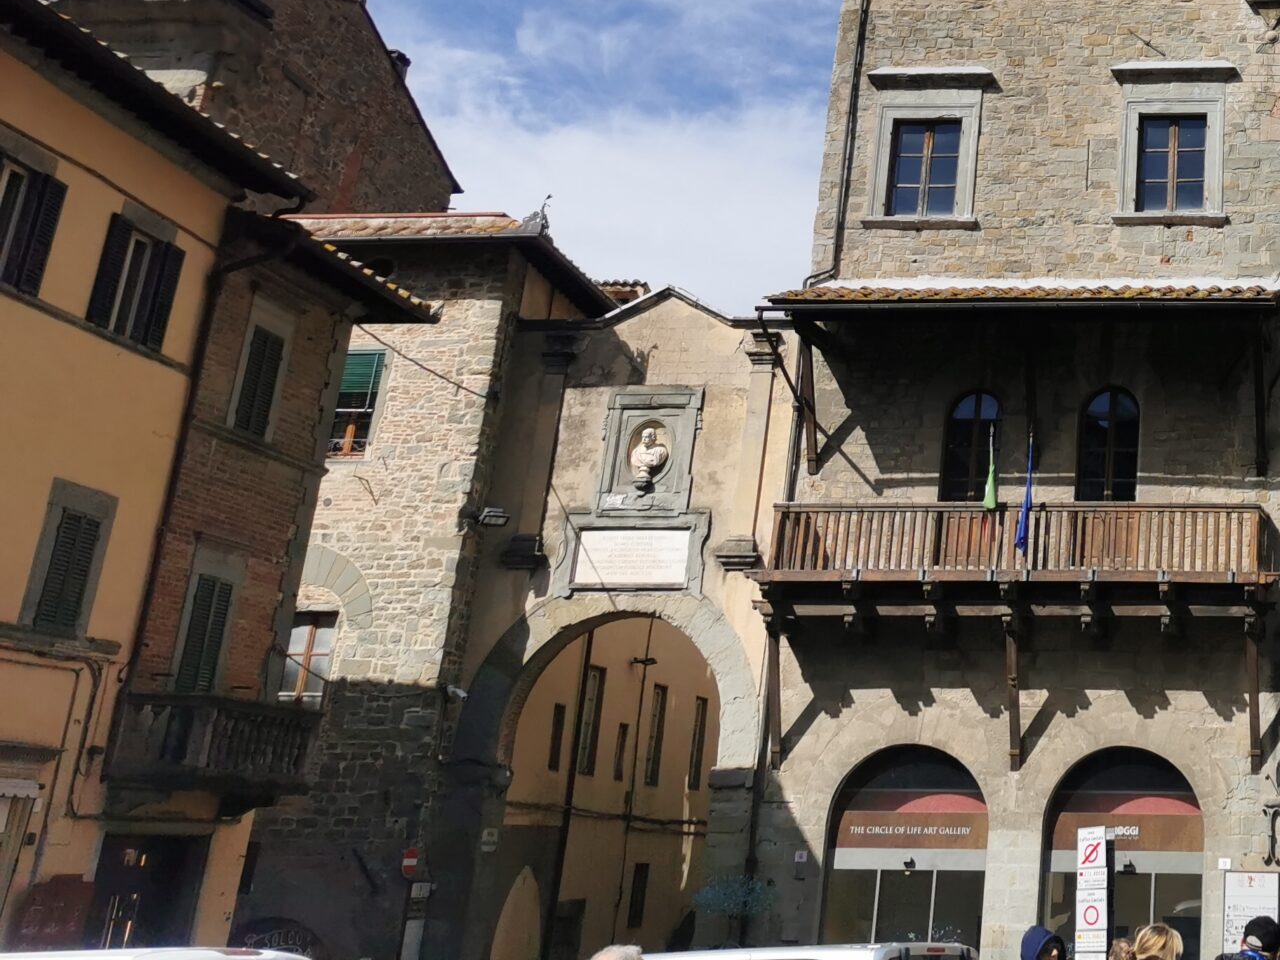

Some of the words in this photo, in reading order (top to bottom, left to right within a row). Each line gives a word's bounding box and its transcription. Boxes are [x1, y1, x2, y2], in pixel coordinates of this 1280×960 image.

[849, 826, 865, 835] THE
[866, 826, 893, 835] CIRCLE
[894, 826, 906, 835] OF
[906, 826, 922, 835] LIFE
[922, 826, 938, 835] ART
[938, 826, 972, 835] GALLERY
